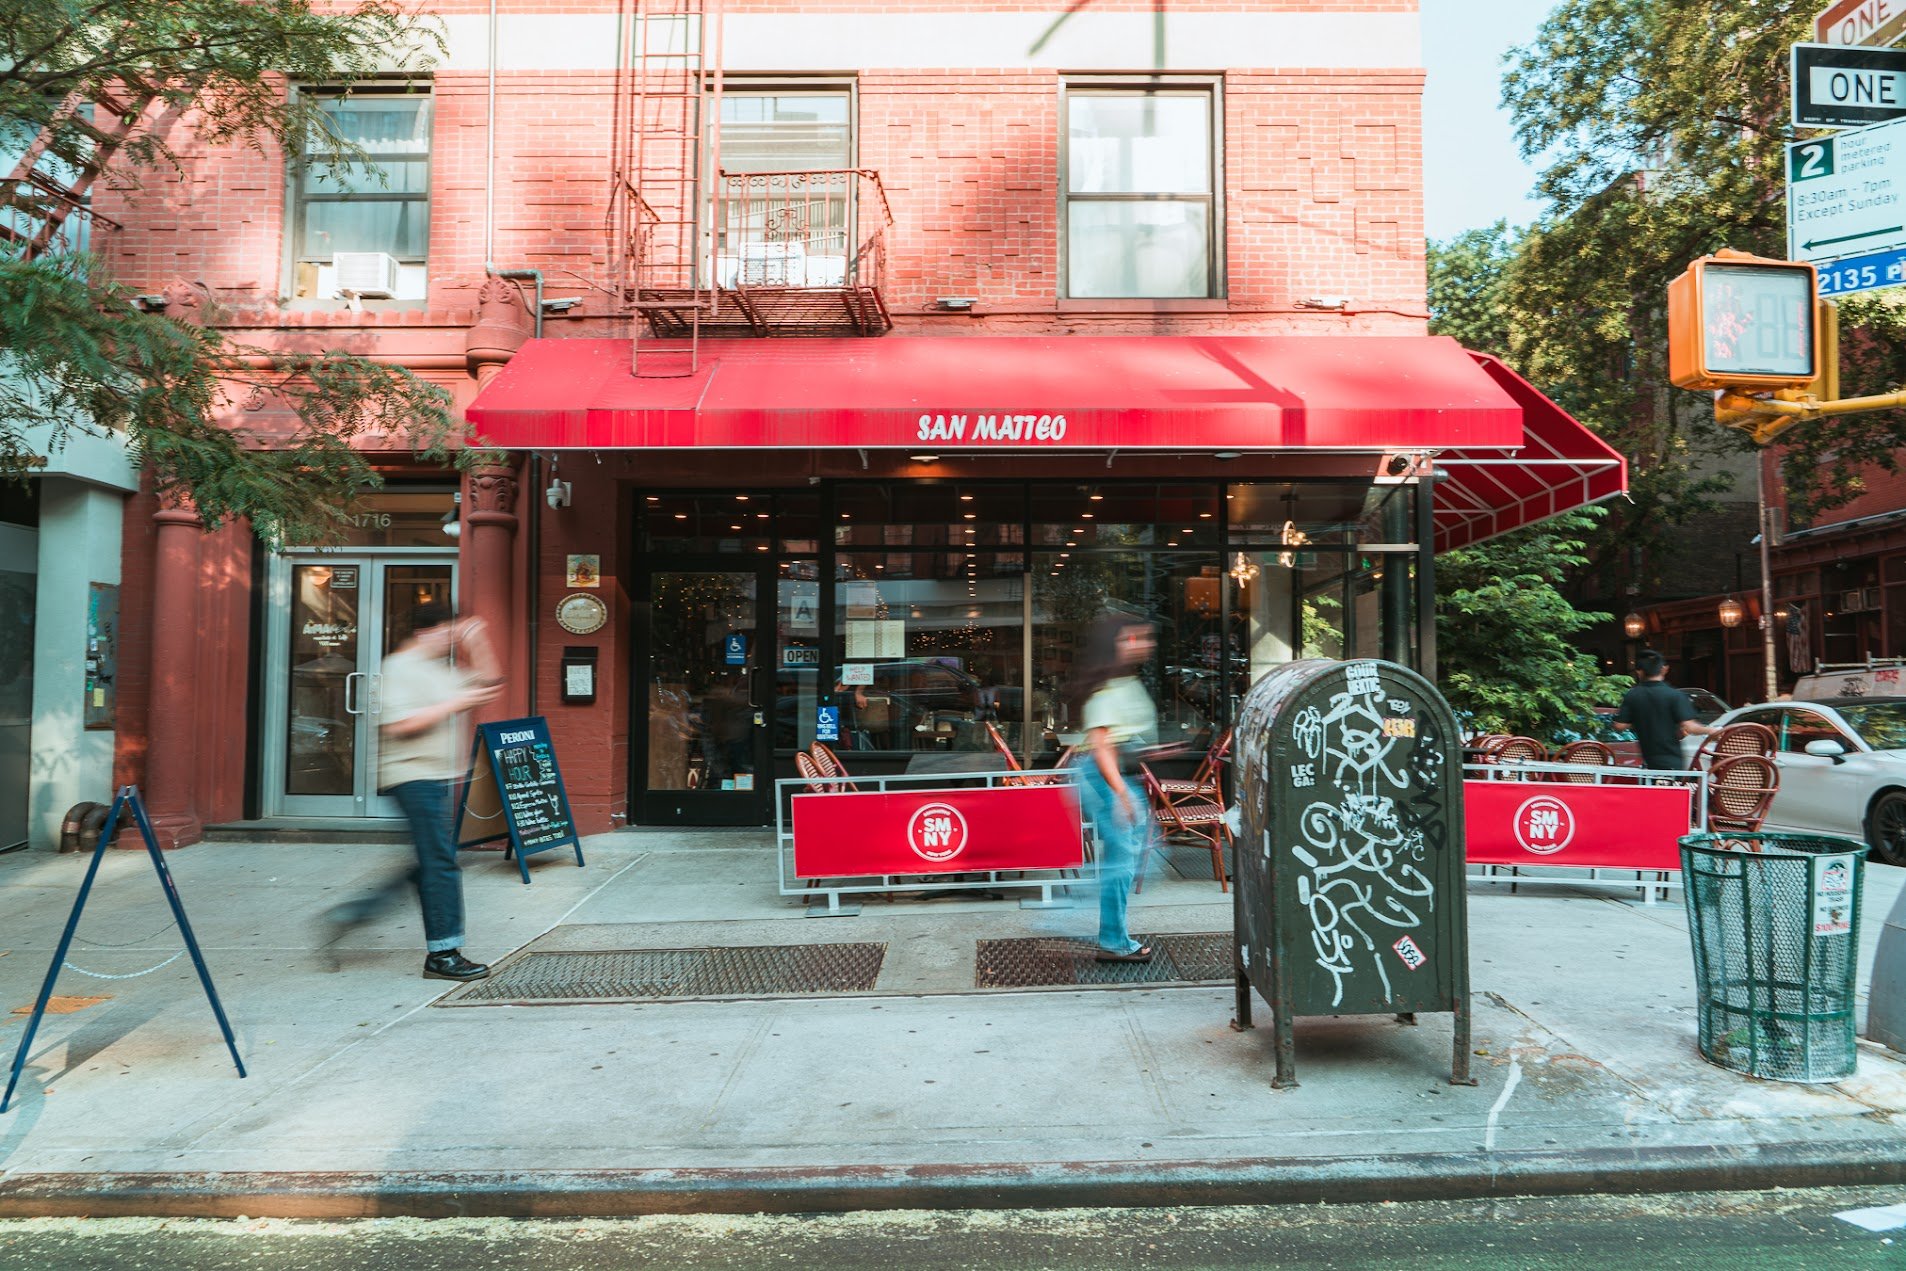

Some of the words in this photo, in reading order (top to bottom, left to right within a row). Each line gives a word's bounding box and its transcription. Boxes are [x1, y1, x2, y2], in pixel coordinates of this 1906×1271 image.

[1842, 0, 1891, 45] ONE
[1831, 72, 1896, 104] ONE
[1841, 137, 1867, 150] hour
[1841, 142, 1891, 161] metered
[1800, 144, 1825, 178] 2
[1841, 156, 1886, 173] parking
[1797, 189, 1847, 207] 8:30am
[1862, 179, 1891, 193] 7pm
[1798, 203, 1843, 221] Except
[1848, 192, 1898, 212] Sunday
[1817, 265, 1877, 294] 2135
[917, 414, 967, 441] SAN
[971, 414, 1067, 441] MATTEO
[352, 513, 392, 528] 1716
[795, 600, 813, 620] A
[786, 650, 818, 664] OPEN
[500, 729, 536, 745] PERONI
[507, 765, 533, 782] HOUR
[923, 817, 952, 832] SM
[1530, 810, 1559, 825] SM
[923, 831, 952, 847] NY
[1529, 824, 1559, 839] NY
